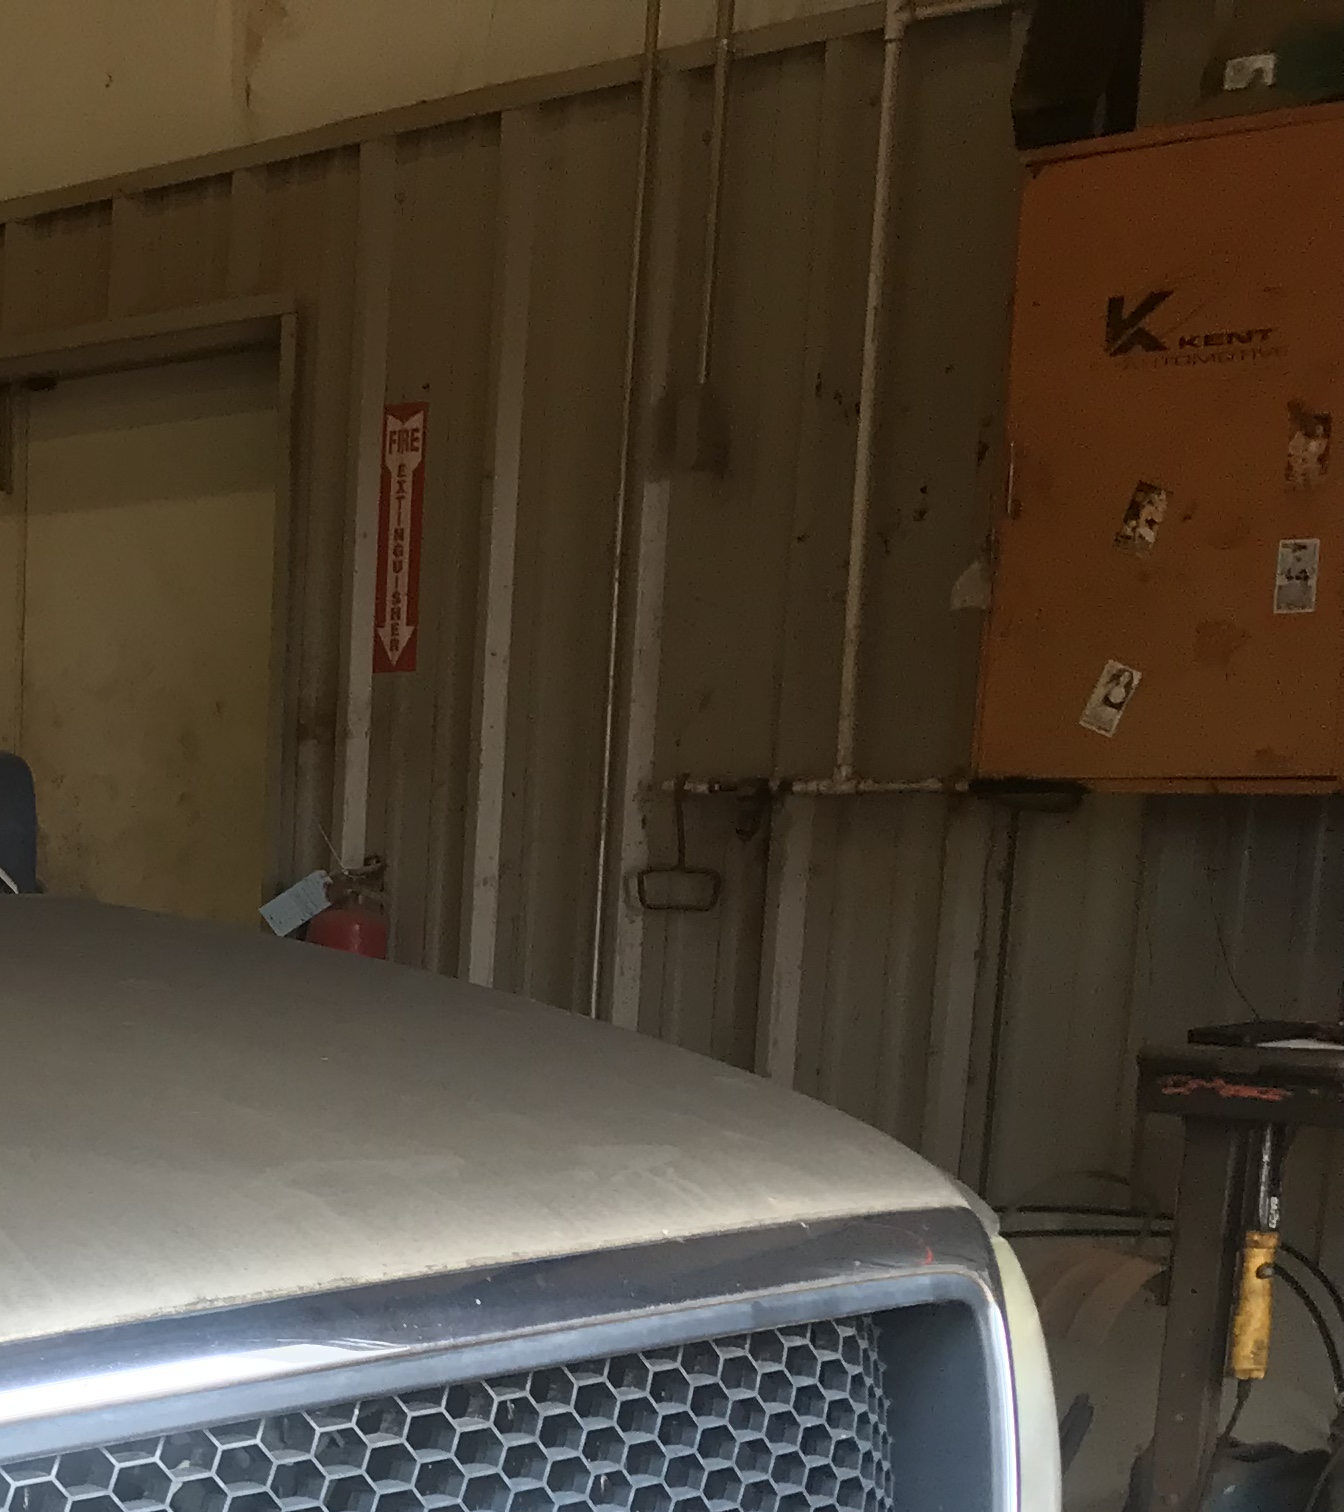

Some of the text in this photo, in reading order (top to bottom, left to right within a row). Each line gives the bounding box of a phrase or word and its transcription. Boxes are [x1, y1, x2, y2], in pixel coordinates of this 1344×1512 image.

[1178, 328, 1273, 349] KENT
[388, 427, 420, 455] FIRE
[389, 464, 406, 652] EXTINGUISHER
